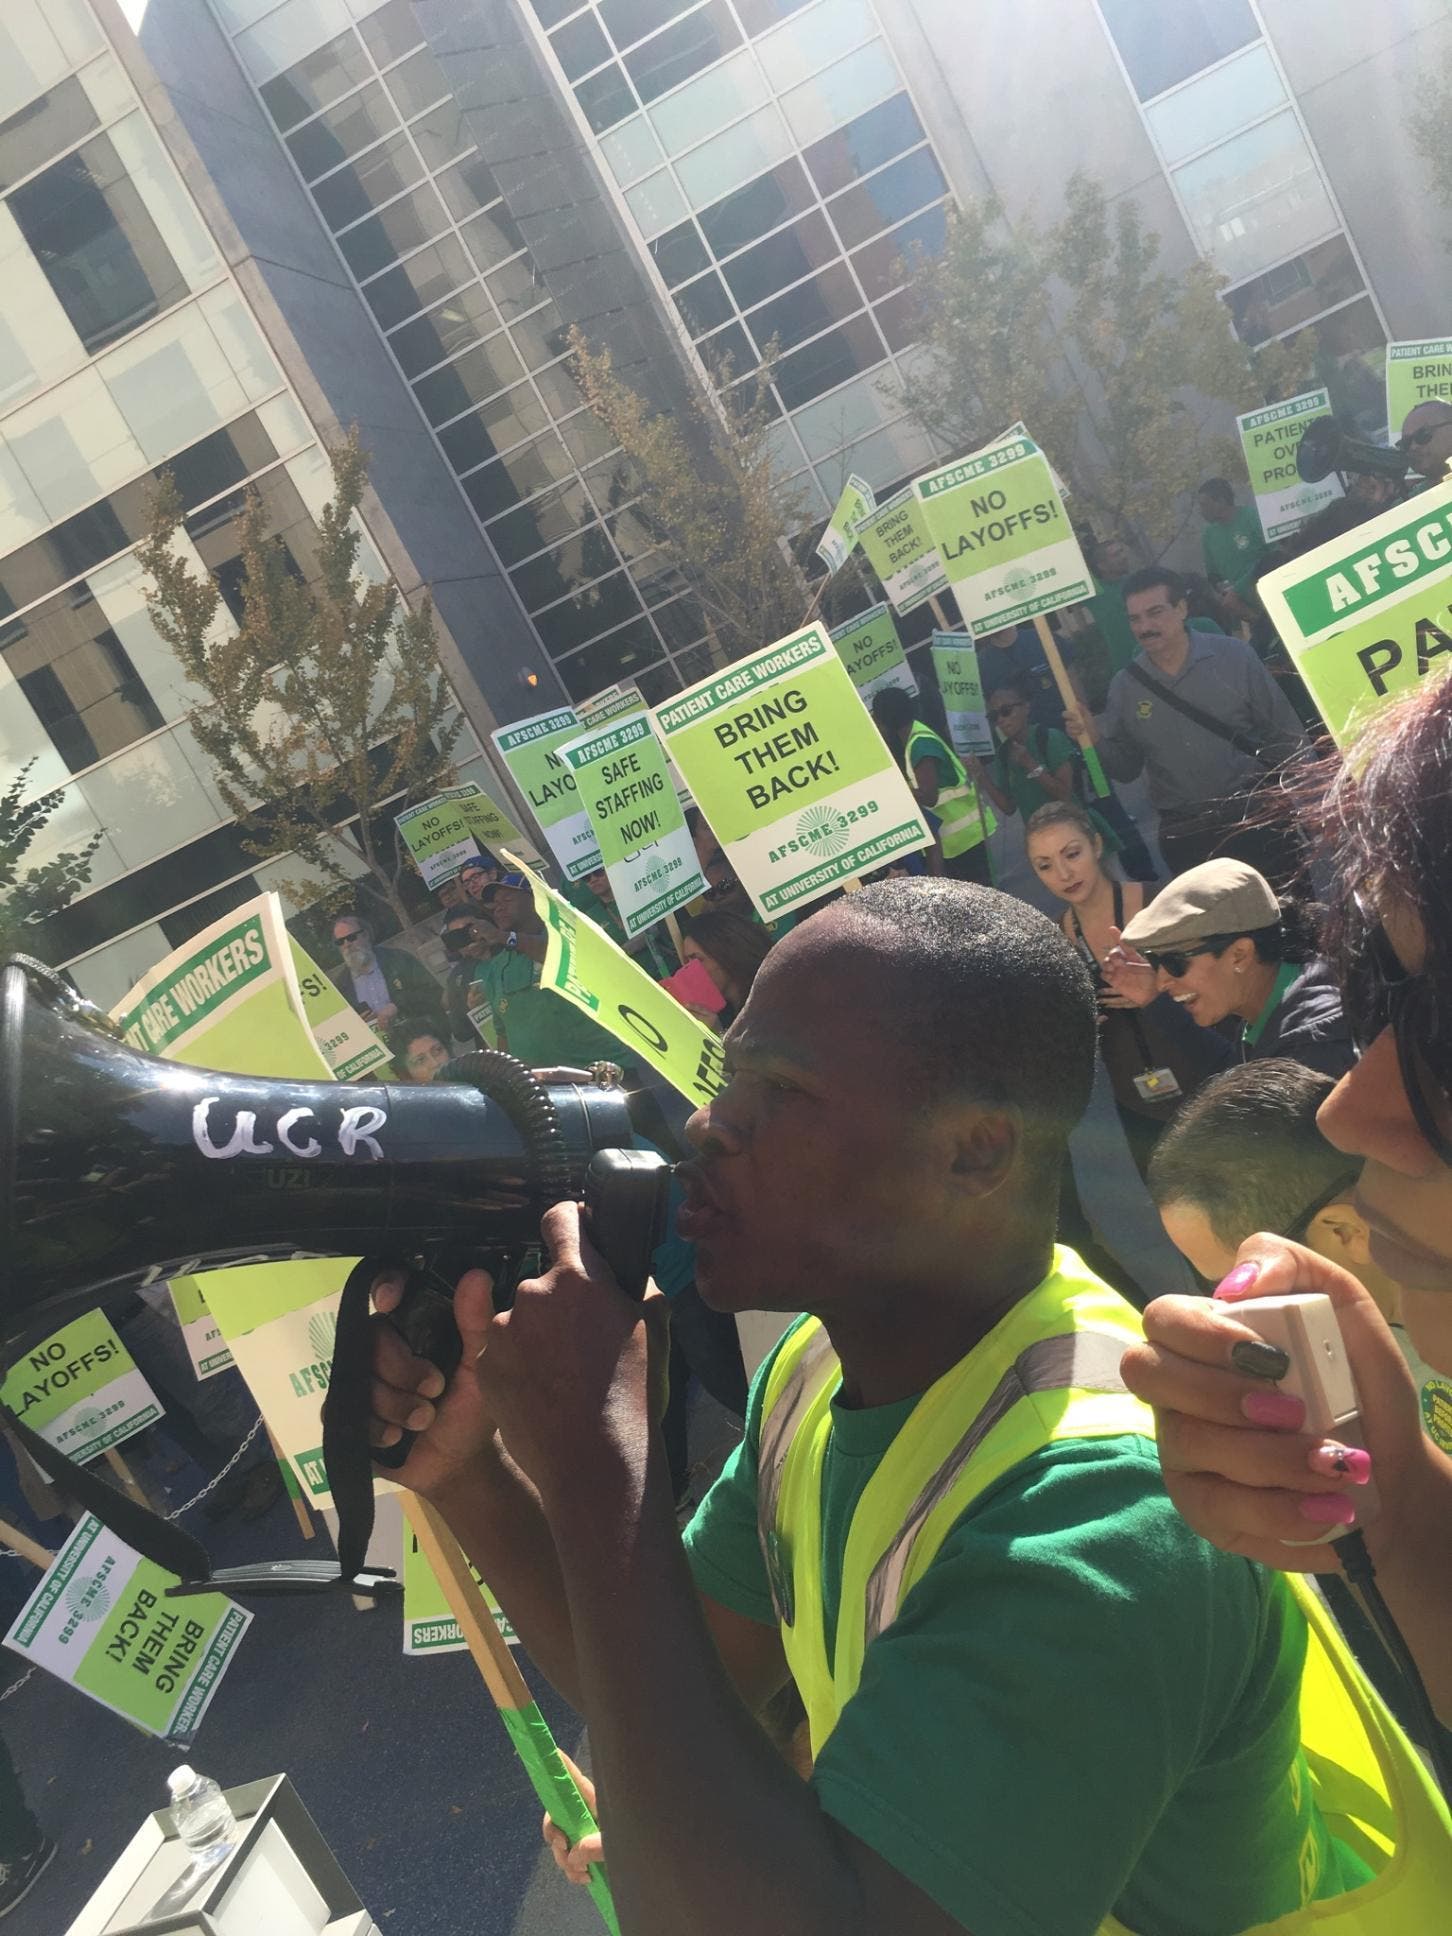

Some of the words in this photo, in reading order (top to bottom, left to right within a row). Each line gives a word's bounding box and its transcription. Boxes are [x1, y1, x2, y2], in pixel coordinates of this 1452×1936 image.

[1391, 346, 1422, 358] PATIENT
[1423, 344, 1444, 354] CARE
[1413, 363, 1452, 379] BRIN
[1250, 405, 1294, 427] AFSCME
[1254, 418, 1315, 447] PATIEN
[1274, 441, 1300, 460] OV
[929, 461, 985, 493] AFSCME
[990, 444, 1026, 469] 3299
[1263, 463, 1297, 483] PRO
[970, 490, 1007, 518] NO
[875, 510, 909, 538] BRING
[884, 524, 914, 549] THEM
[941, 500, 1059, 561] LAYOFFS!
[889, 536, 921, 564] BACK!
[1326, 512, 1452, 613] AFSC
[984, 579, 1026, 601] AFSCME
[846, 639, 897, 675] AYOFFS!
[853, 634, 873, 654] NO
[1356, 604, 1452, 697] PA
[660, 692, 714, 731] PATIENT
[715, 672, 754, 701] CARE
[751, 635, 822, 682] WORKERS
[507, 723, 550, 746] AFSCME
[550, 714, 572, 731] 3299
[714, 690, 808, 748] BRING
[544, 750, 567, 770] N
[577, 736, 619, 764] AFSCME
[622, 723, 645, 745] 3299
[734, 722, 819, 775] THEM
[602, 753, 641, 785] SAFE
[746, 750, 840, 809] BACK!
[528, 773, 577, 807] LAYO
[595, 772, 664, 820] STAFFING
[411, 819, 465, 852] LAYOFFS!
[422, 816, 440, 831] NO
[620, 810, 661, 845] NOW!
[768, 823, 833, 863] AFSCME
[836, 800, 879, 828] 3299
[634, 867, 663, 893] AFSCME
[664, 857, 683, 874] 3299
[764, 893, 779, 909] AT
[780, 863, 841, 900] UNIVERSITY
[841, 857, 856, 871] OF
[856, 825, 922, 862] CALIFORNIA
[629, 919, 638, 929] AT
[637, 902, 667, 923] UNIVERSITY
[142, 994, 180, 1045] CARE
[169, 928, 265, 1017] WORKERS
[300, 973, 328, 998] S!
[324, 1032, 350, 1051] 3299
[336, 1068, 347, 1081] OF
[192, 1096, 387, 1160] UCR
[29, 1342, 66, 1372] NO
[289, 1360, 334, 1398] AFSC
[56, 1416, 98, 1443] AFSCME
[303, 1462, 323, 1486] AT
[58, 1531, 93, 1580] UNIVERSITY
[49, 1579, 62, 1594] OF
[80, 1555, 116, 1608] AFSCME
[17, 1592, 55, 1644] CALIFORNIA
[58, 1610, 84, 1645] 3299
[105, 1588, 158, 1663] BACK!
[216, 1611, 243, 1657] PATIENT
[413, 1623, 464, 1644] ORKERS
[132, 1612, 180, 1676] THEM
[155, 1619, 205, 1694] BRING
[198, 1655, 220, 1687] CARE
[172, 1687, 206, 1735] WORKER
